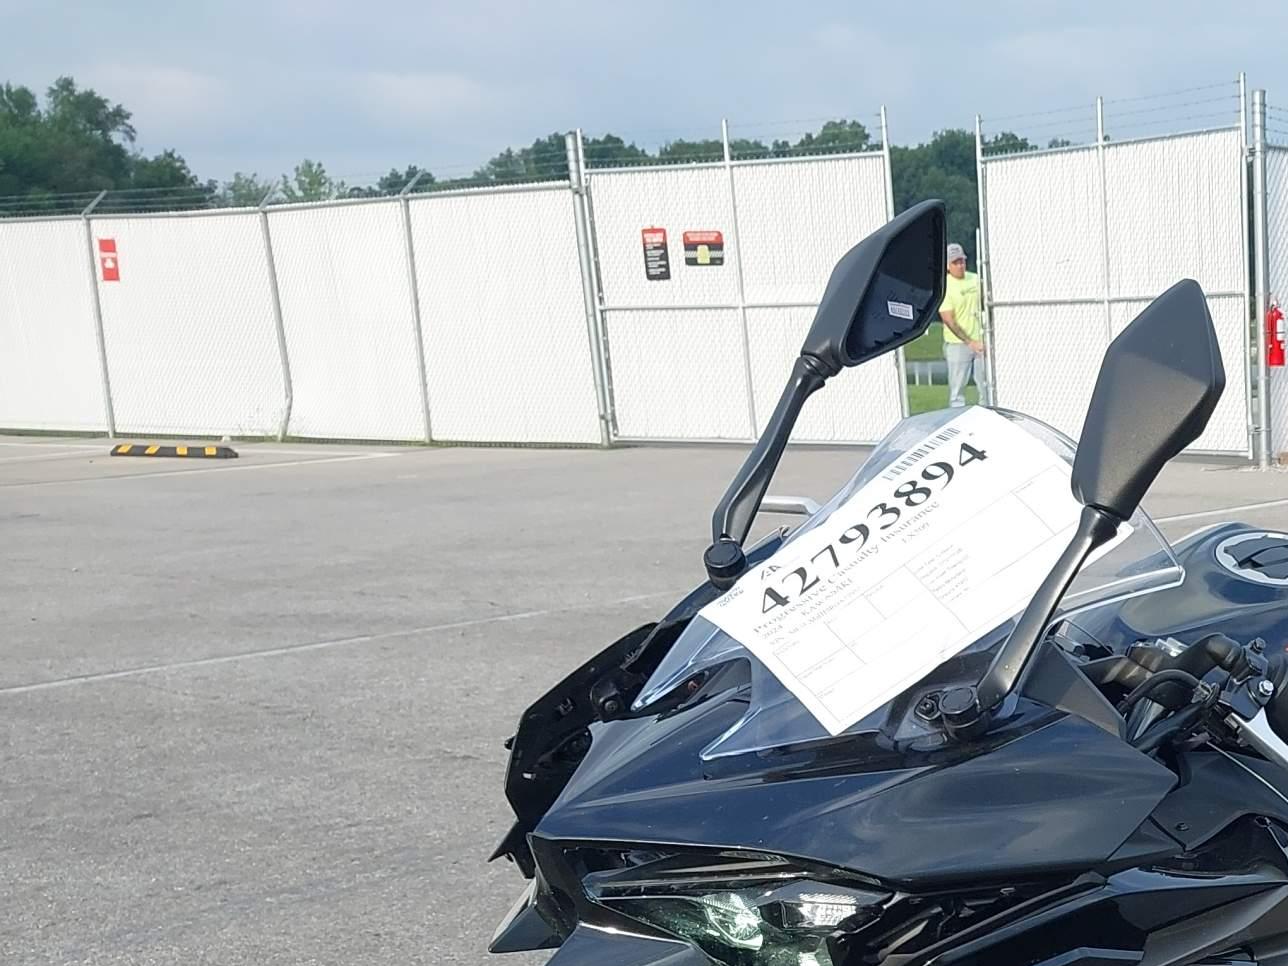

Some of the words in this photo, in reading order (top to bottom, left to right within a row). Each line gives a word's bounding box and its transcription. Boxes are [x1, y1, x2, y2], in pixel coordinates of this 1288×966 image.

[753, 584, 828, 634] Progressive
[827, 543, 880, 585] Casualty
[880, 501, 940, 543] Insurance
[762, 442, 988, 614] 42793894
